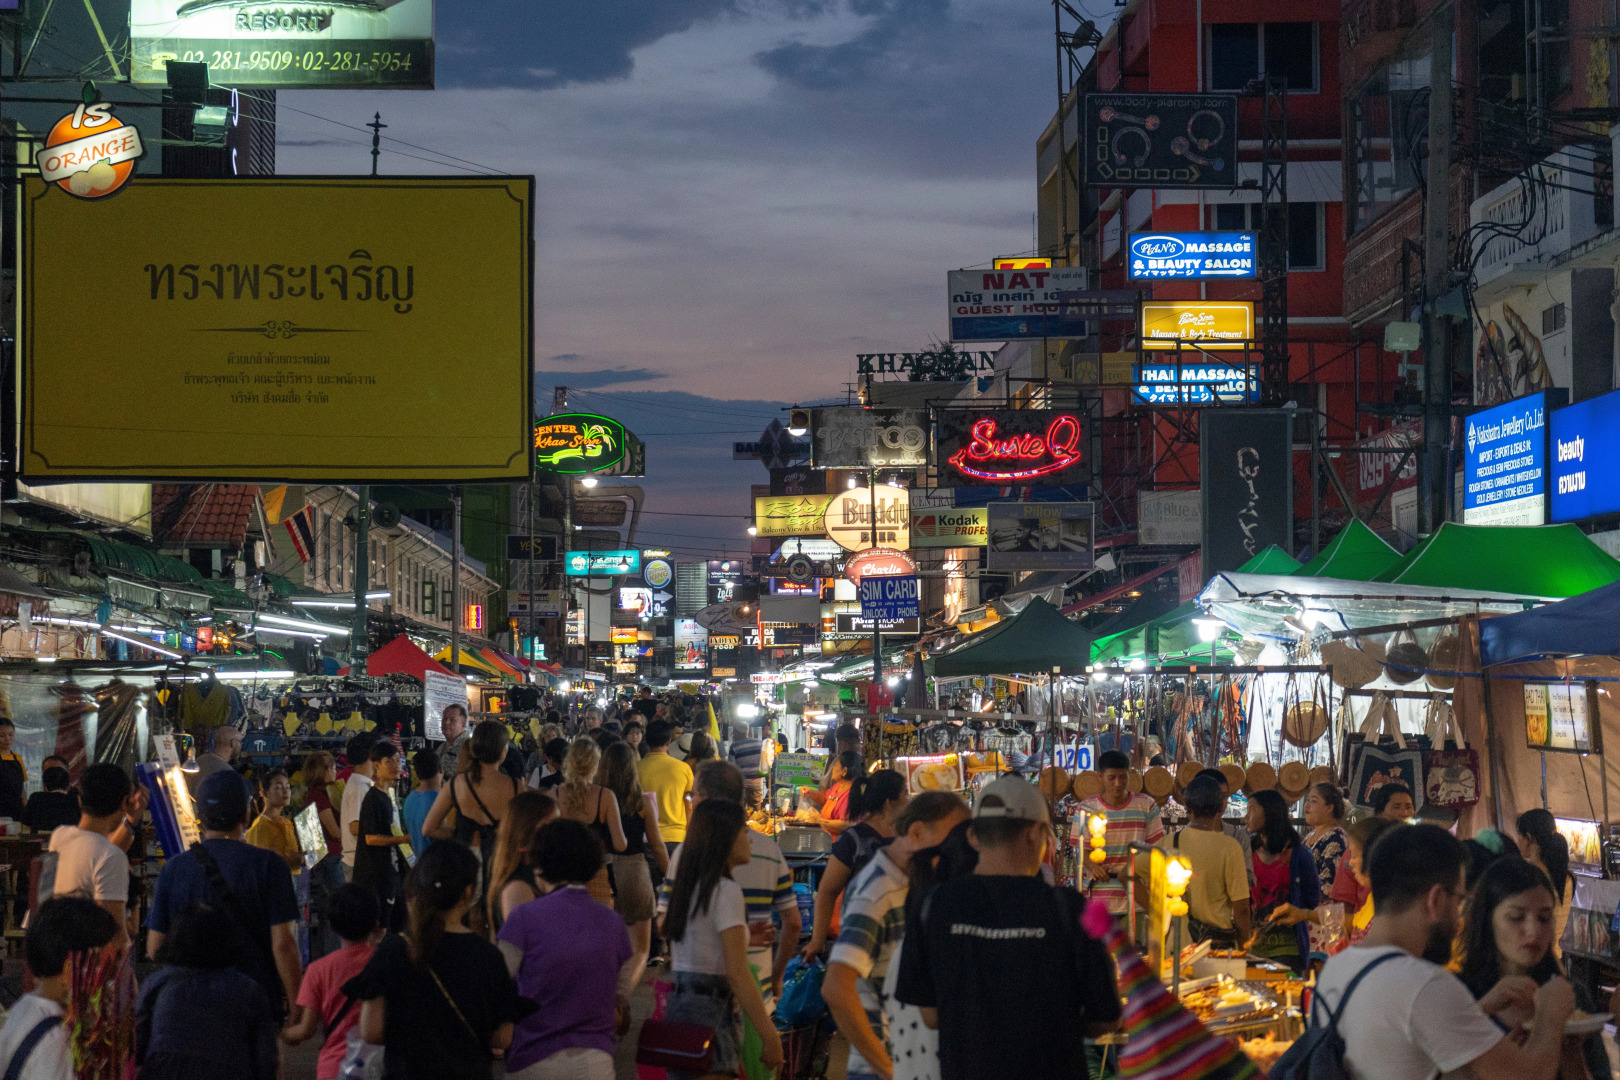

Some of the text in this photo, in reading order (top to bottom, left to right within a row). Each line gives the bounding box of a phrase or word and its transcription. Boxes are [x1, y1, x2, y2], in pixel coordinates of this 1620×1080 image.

[235, 13, 325, 31] RESORT
[71, 102, 112, 129] IS
[45, 134, 136, 172] ORANGE
[1186, 242, 1251, 253] MASSAGE
[1133, 259, 1252, 269] & BEAUTY SALON
[144, 248, 415, 315] ทรงพระเจริญ
[983, 271, 1048, 290] NAT
[957, 305, 1013, 315] GUEST
[1066, 298, 1108, 315] ATM
[1151, 329, 1179, 338] Massage
[1208, 329, 1243, 338] Treatment
[1142, 367, 1256, 382] THAI MASSAGE
[1501, 415, 1524, 439] Jewellery
[970, 415, 1082, 459] Susie Q
[1557, 434, 1585, 463] beauty
[842, 497, 910, 529] Buddy
[939, 515, 979, 526] Kodak
[1023, 505, 1063, 519] Pillow
[762, 526, 786, 535] Balcony
[787, 524, 803, 532] View
[862, 562, 902, 575] Charlie
[862, 579, 917, 601] SIM CARD
[863, 608, 888, 619] UNLOCK
[897, 606, 918, 617] PHONE
[1056, 747, 1092, 771] 120
